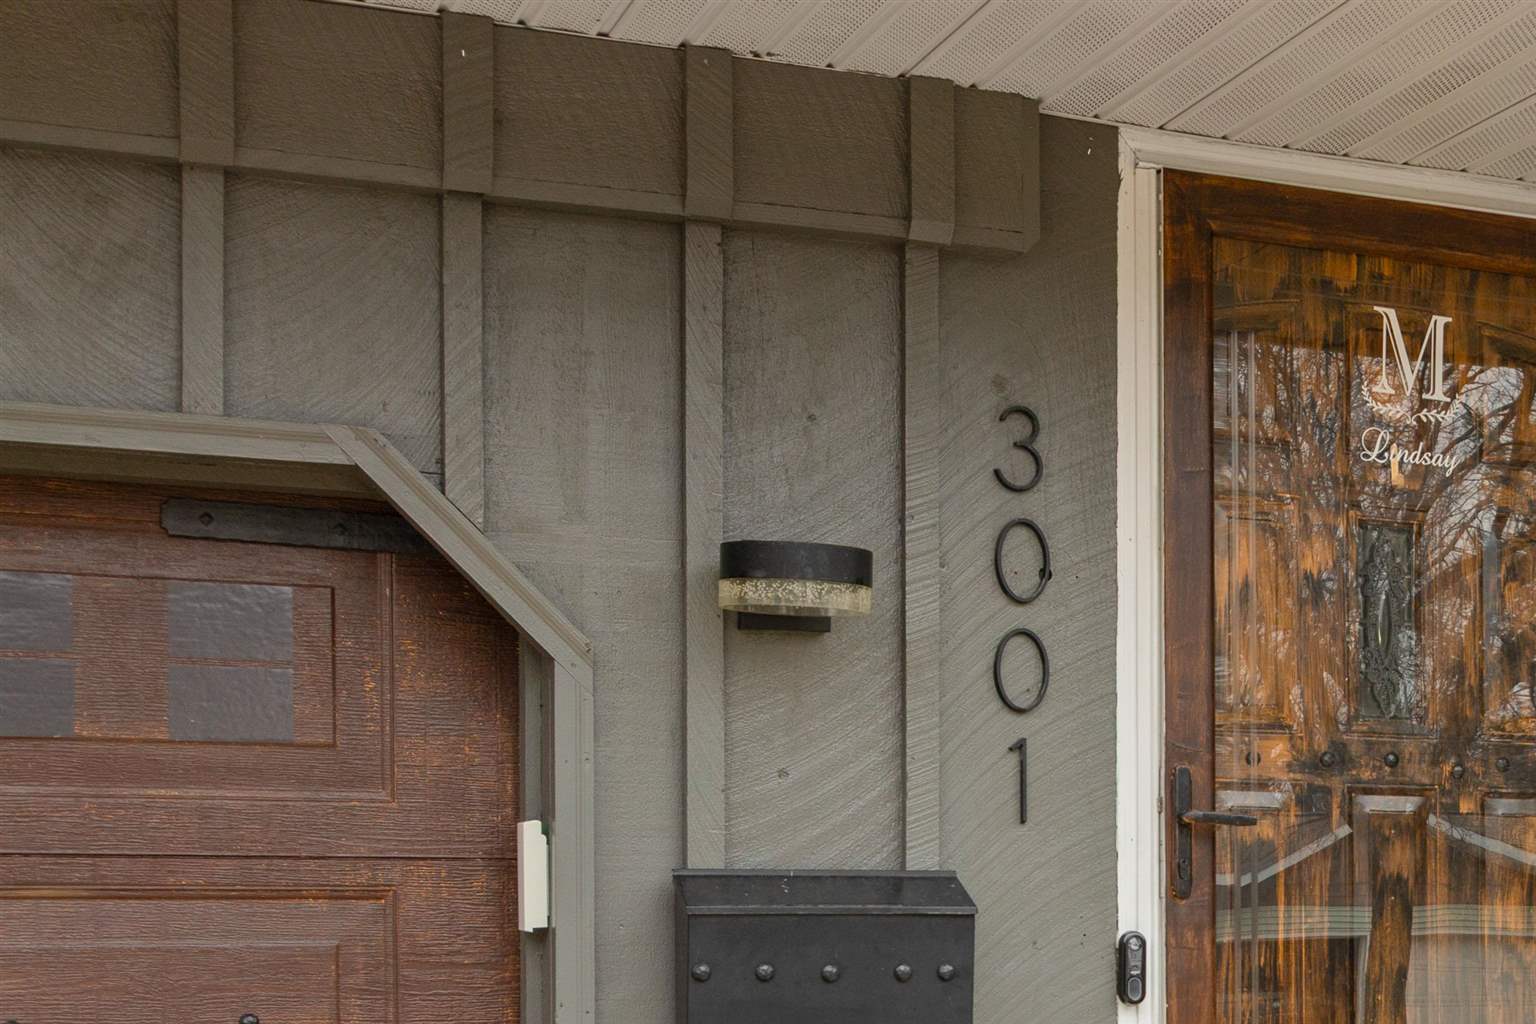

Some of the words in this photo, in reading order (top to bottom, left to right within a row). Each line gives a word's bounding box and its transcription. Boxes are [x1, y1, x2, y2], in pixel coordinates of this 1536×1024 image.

[1372, 305, 1453, 401] M
[1360, 427, 1461, 477] Lindsay
[993, 405, 1051, 824] 3001
